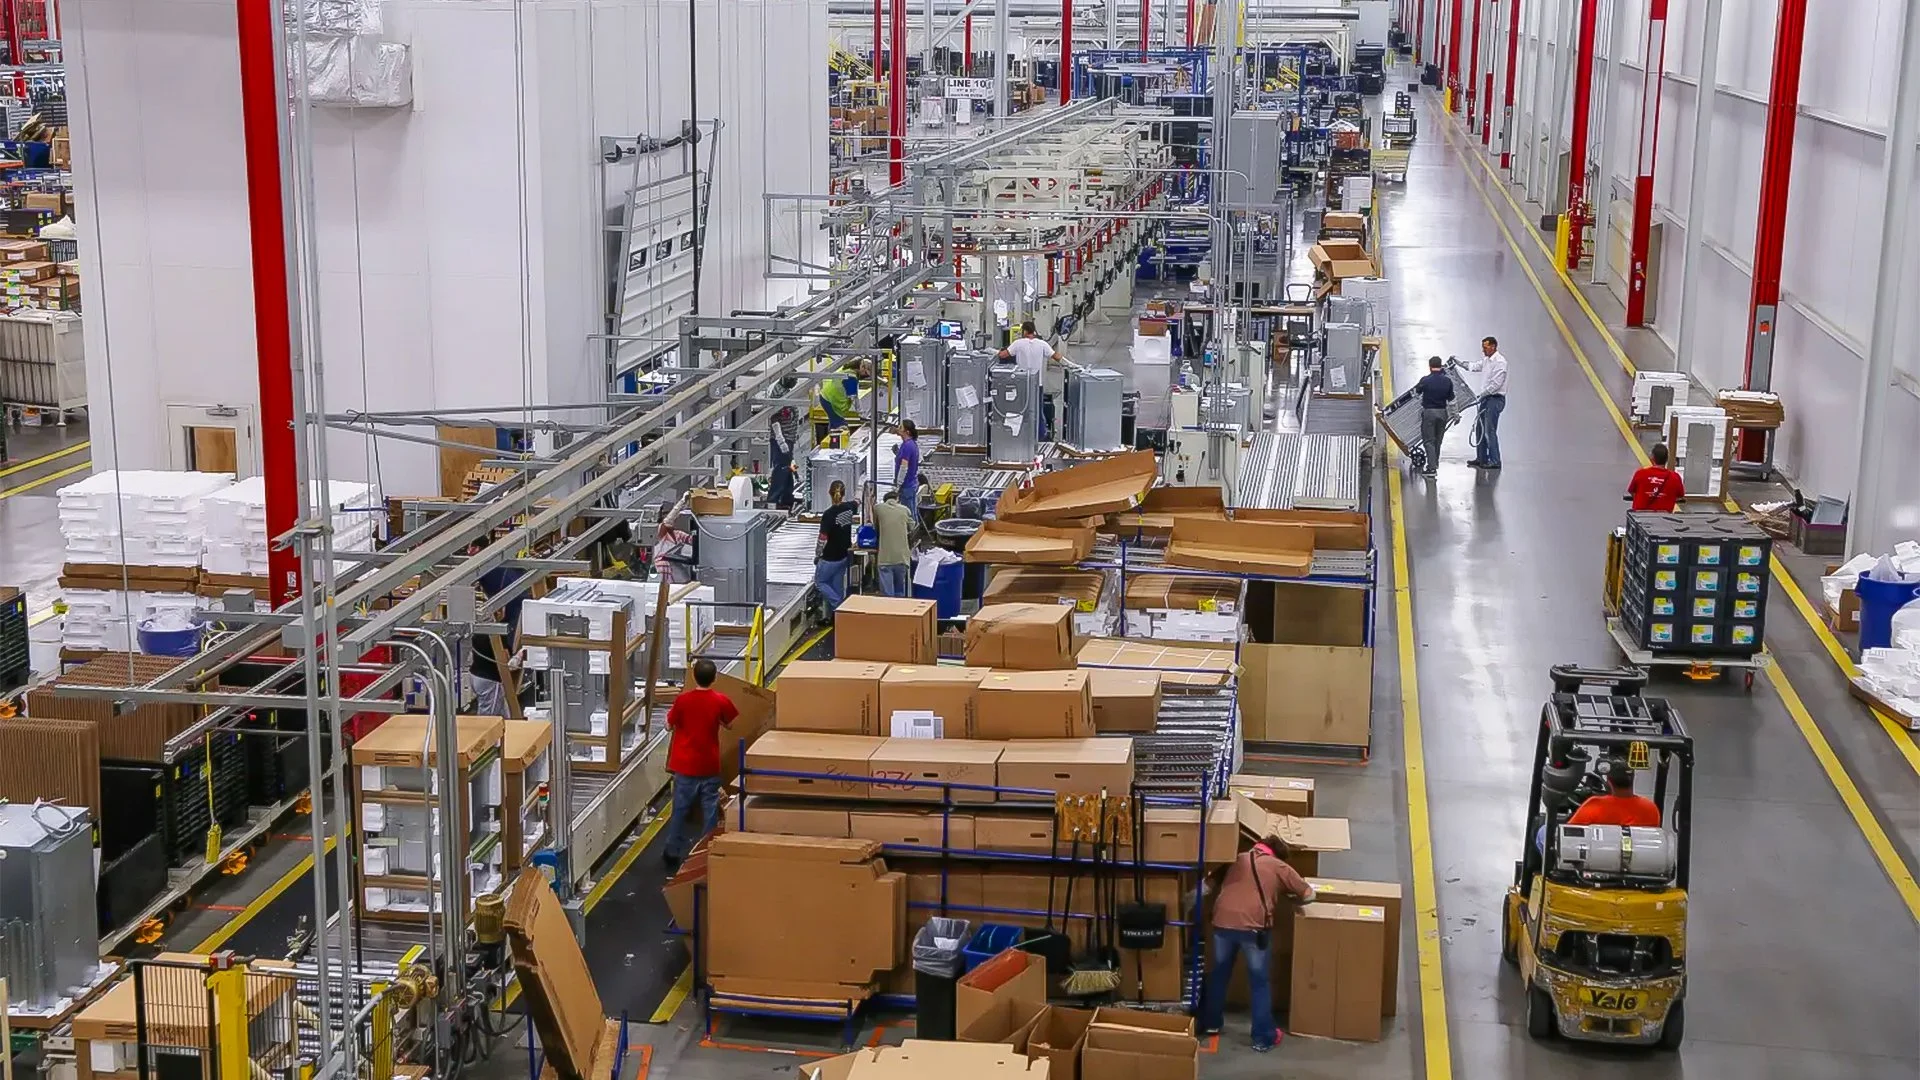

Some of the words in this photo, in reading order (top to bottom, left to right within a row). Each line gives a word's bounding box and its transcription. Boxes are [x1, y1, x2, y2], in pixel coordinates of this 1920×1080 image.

[947, 79, 971, 88] LINE
[974, 80, 987, 88] 10
[1590, 989, 1638, 1011] Yale
